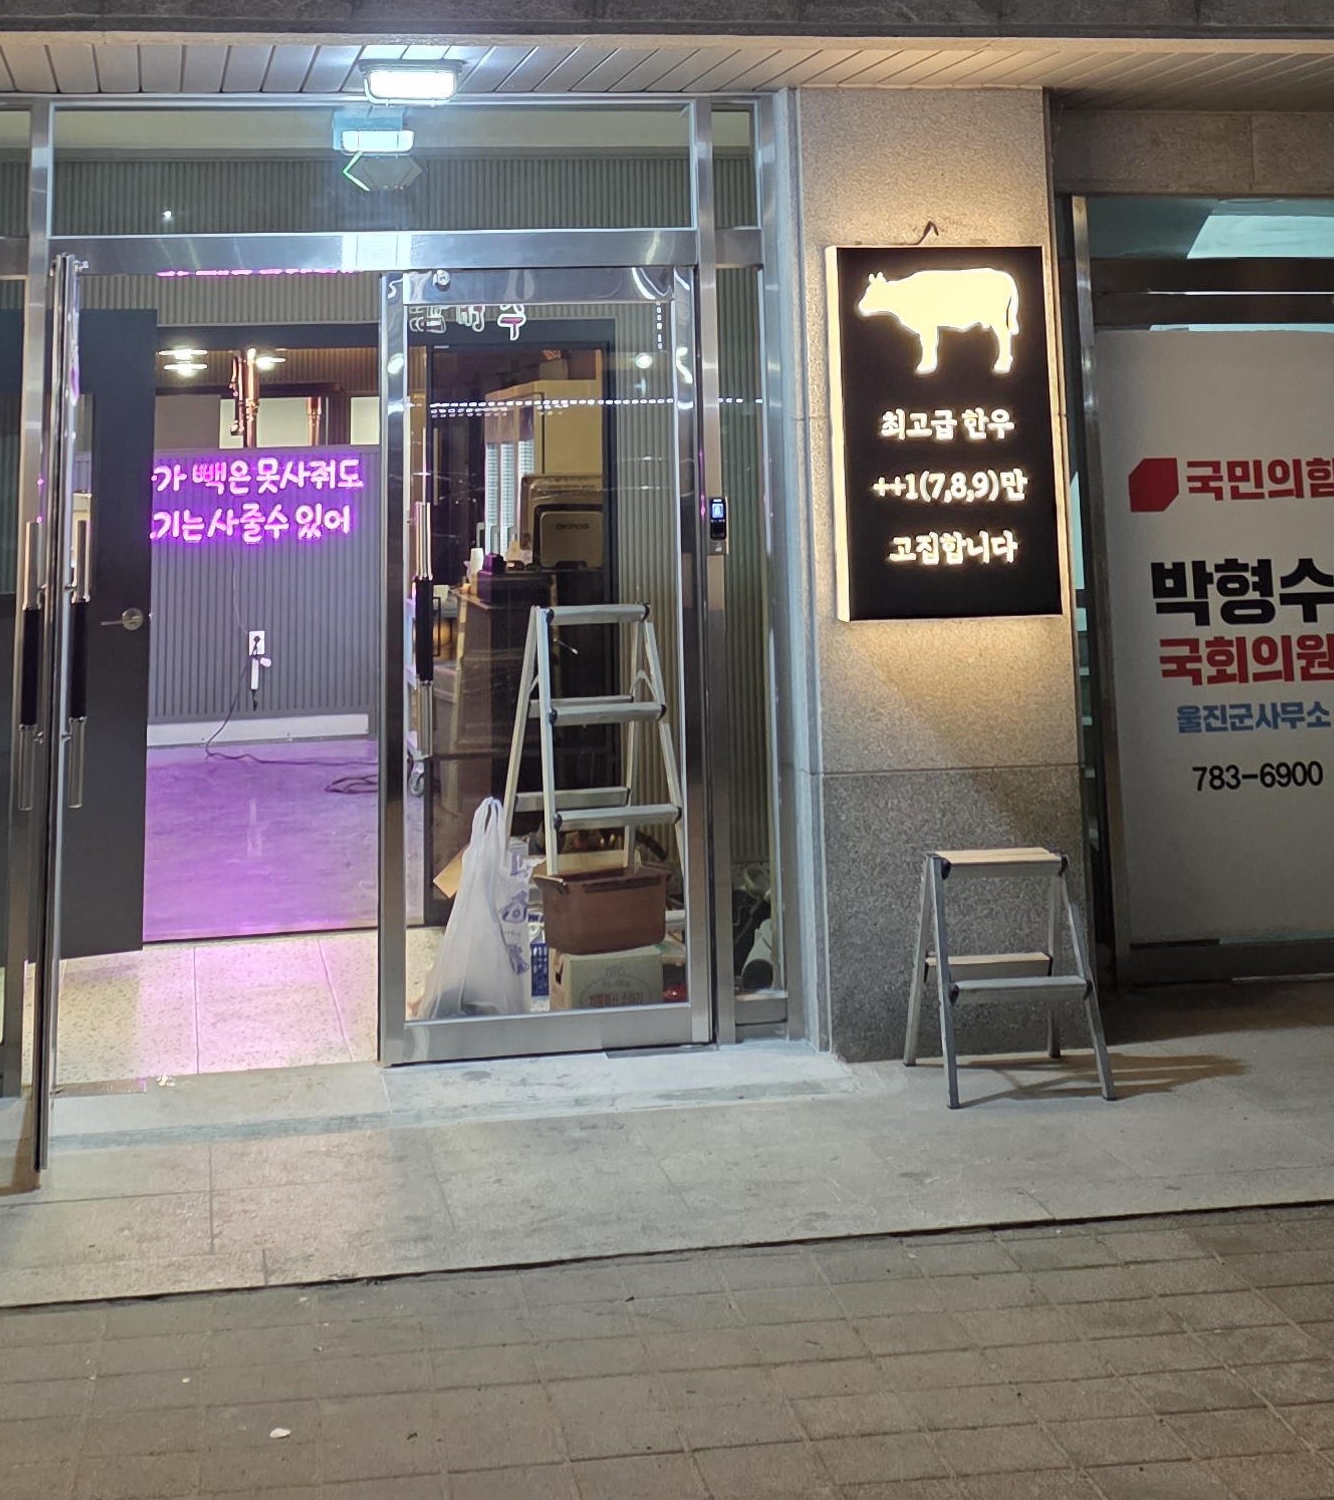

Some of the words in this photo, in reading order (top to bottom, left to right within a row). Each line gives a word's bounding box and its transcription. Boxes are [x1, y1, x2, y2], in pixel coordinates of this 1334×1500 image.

[880, 409, 957, 441] 최고급
[961, 408, 1016, 440] 한우
[151, 464, 188, 493] 가
[295, 503, 350, 539] 있어
[888, 529, 1019, 565] 고집합니다
[1176, 700, 1332, 734] 울진군사무소
[1192, 761, 1324, 792] 783-6900
